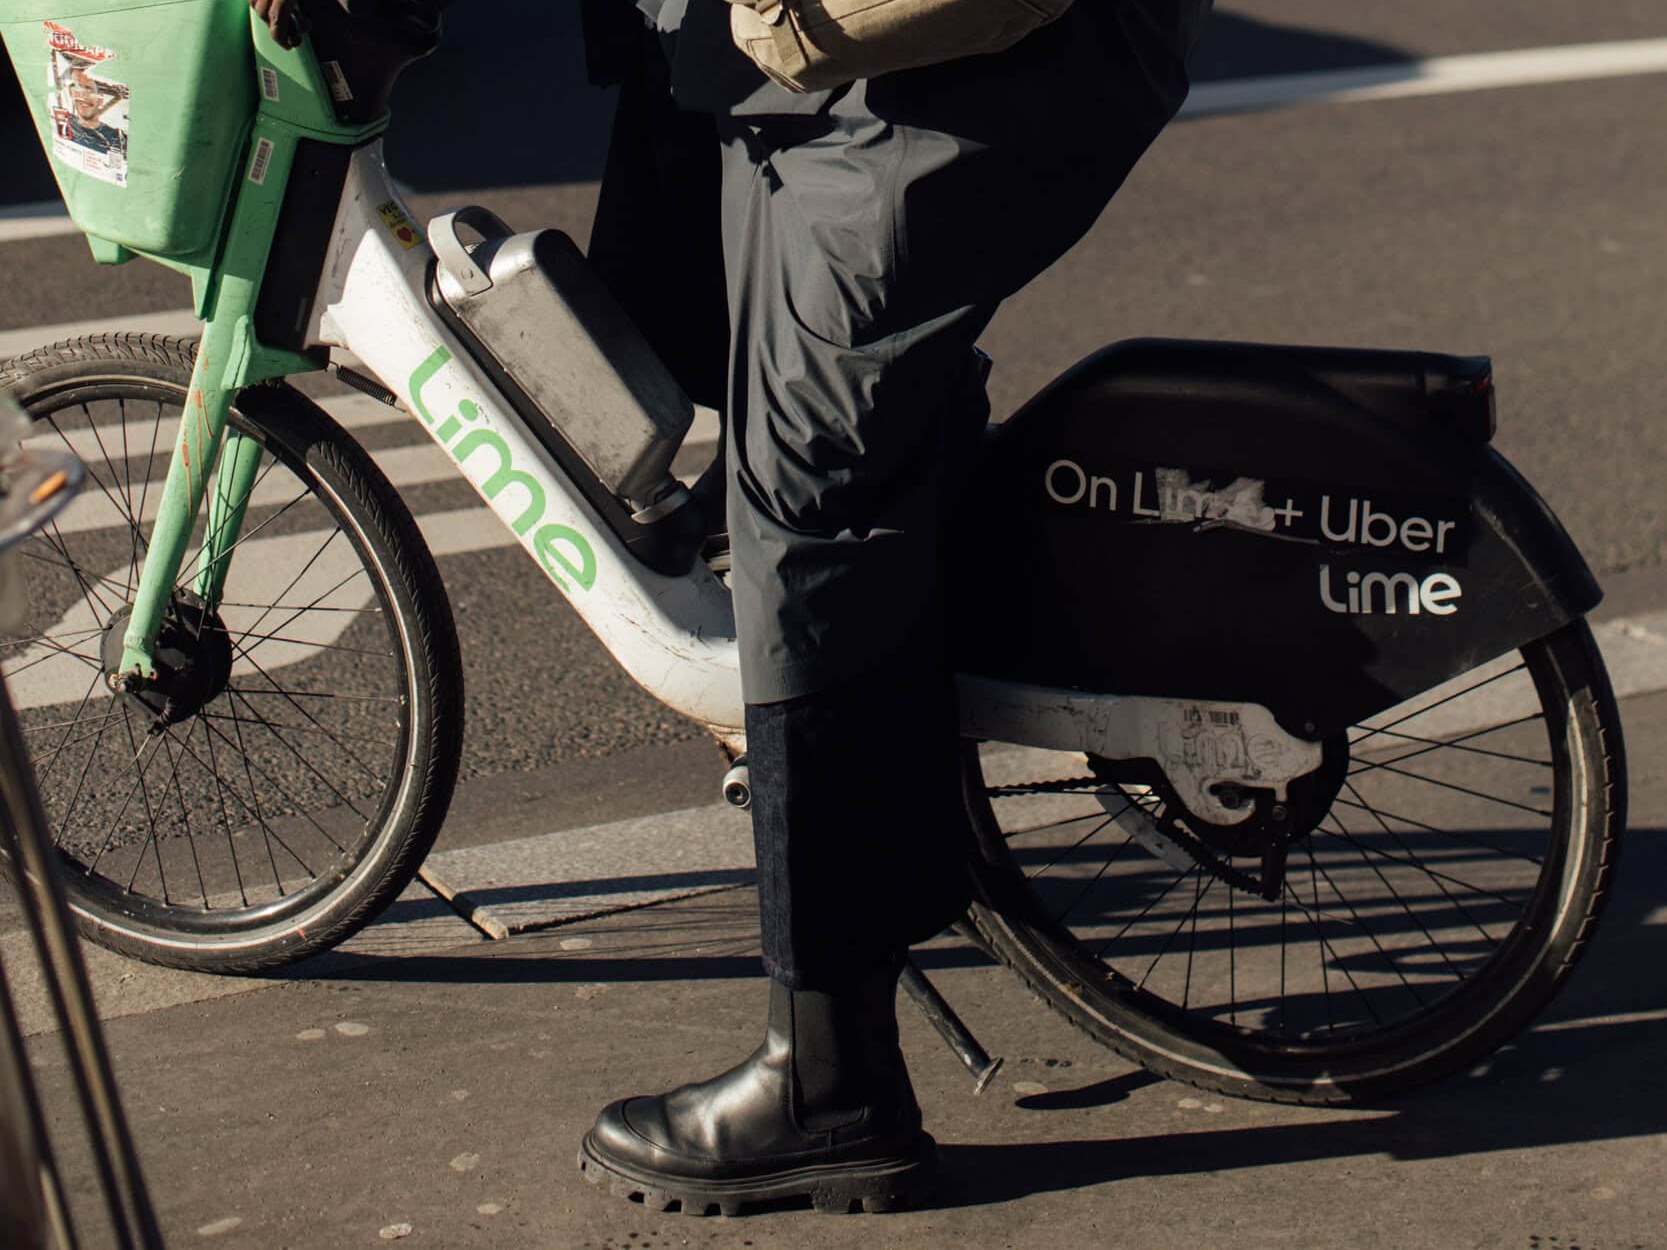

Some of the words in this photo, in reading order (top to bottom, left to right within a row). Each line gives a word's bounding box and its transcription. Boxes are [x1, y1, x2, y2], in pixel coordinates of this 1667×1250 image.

[408, 344, 597, 594] Lime
[1045, 459, 1117, 511] On
[1132, 471, 1264, 526] Lim
[1319, 494, 1456, 554] Uber
[1319, 564, 1463, 616] Lime
